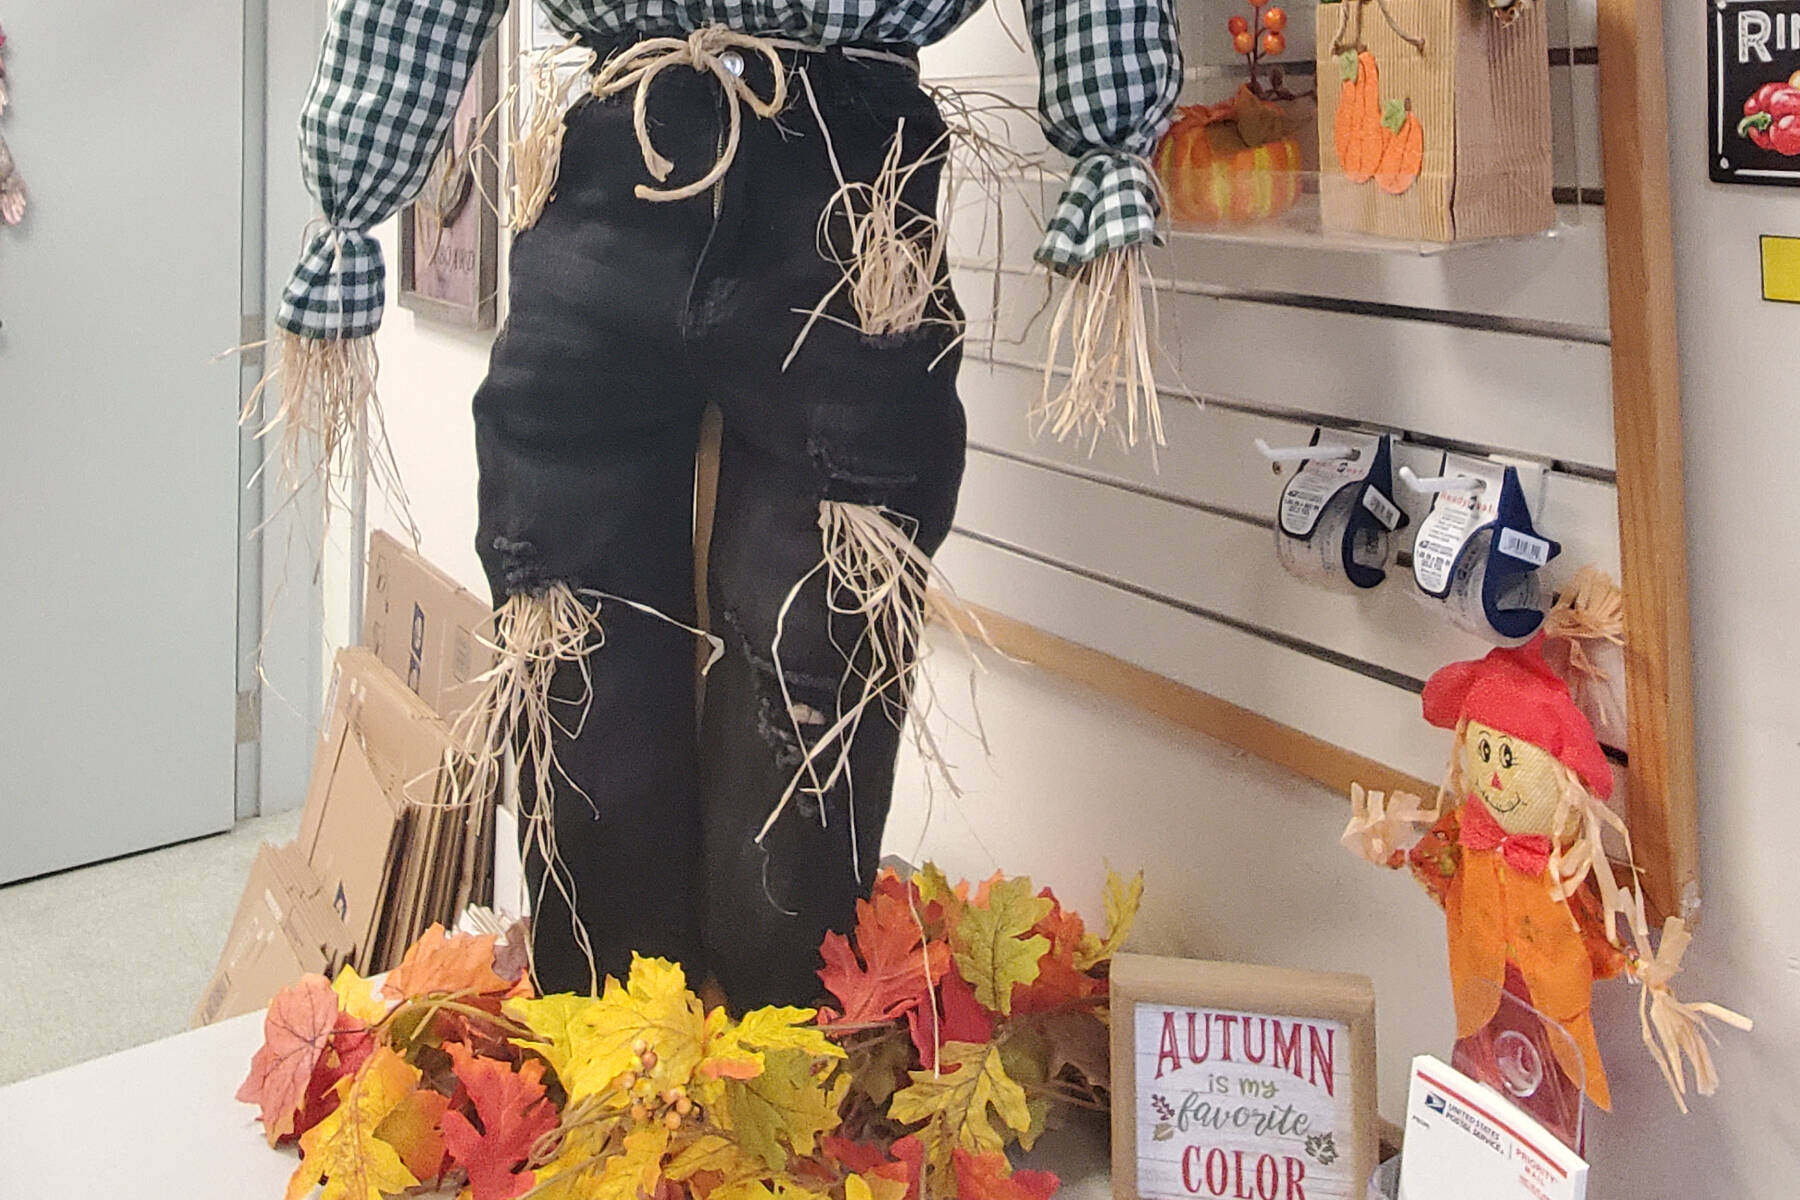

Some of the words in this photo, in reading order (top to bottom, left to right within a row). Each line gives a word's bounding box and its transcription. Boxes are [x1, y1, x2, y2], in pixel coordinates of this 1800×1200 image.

[1154, 1010, 1335, 1098] AUTUMN
[1208, 1073, 1230, 1095] is
[1239, 1077, 1280, 1099] my
[1176, 1090, 1313, 1137] favorite
[1445, 1111, 1472, 1133] POSTAL
[1448, 1103, 1475, 1124] UNITED
[1476, 1120, 1500, 1141] STATES
[1181, 1144, 1307, 1200] COLOR
[1515, 1148, 1556, 1184] PRIORITY
